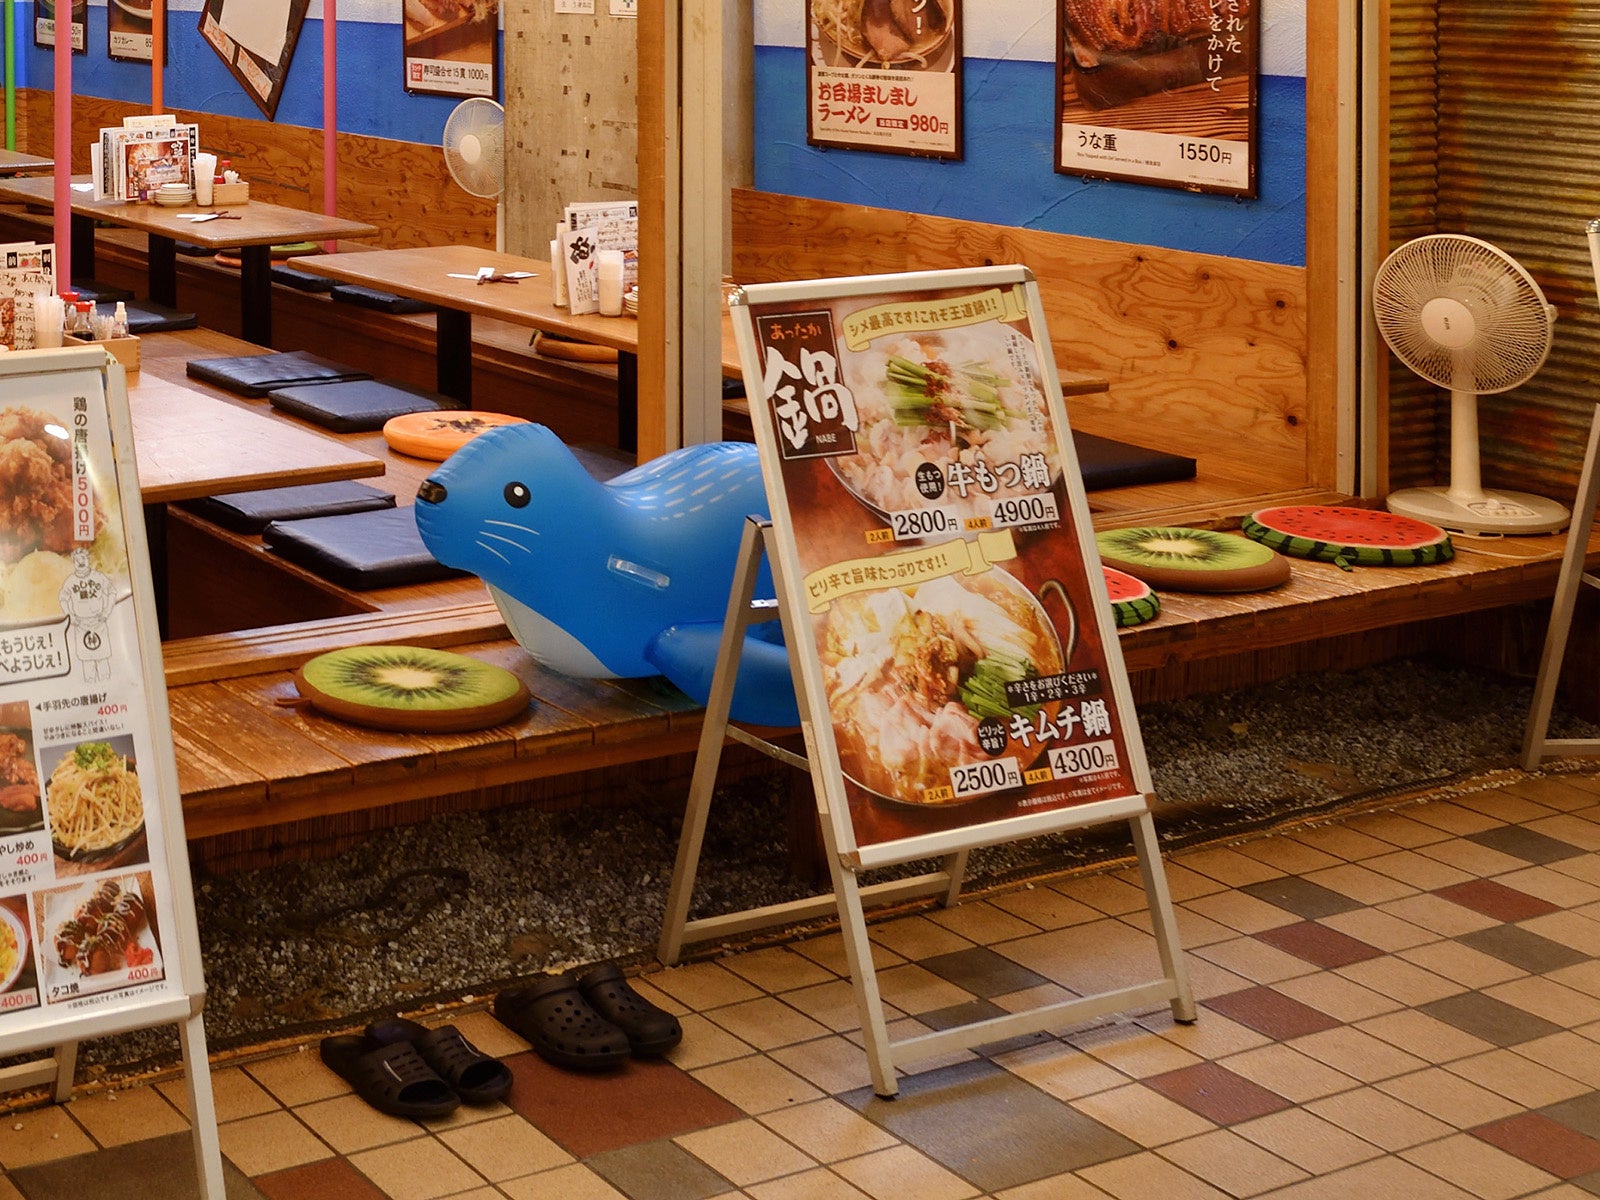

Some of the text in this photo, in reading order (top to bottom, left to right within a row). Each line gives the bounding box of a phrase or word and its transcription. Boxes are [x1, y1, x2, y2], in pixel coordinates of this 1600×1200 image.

[817, 103, 871, 125] ラーメン
[909, 114, 949, 135] 980円
[1077, 129, 1232, 165] うな重 1550円
[770, 321, 822, 341] あったか
[849, 297, 998, 337] シメ最高です!これぞ王道鍋!!
[763, 346, 860, 450] 鍋
[815, 433, 837, 444] NABE
[947, 452, 1051, 498] 牛もつ鍋
[869, 497, 1056, 543] 2人前 2800円 4人前 4900円
[43, 692, 108, 712] 手羽先の唐揚げ
[97, 703, 128, 716] 400円
[1010, 698, 1112, 749] キムチ鍋
[927, 745, 1115, 801] 2人前 2500円 4人前 4300円
[16, 852, 48, 866] 400円
[51, 966, 159, 997] タコ焼 400円
[0, 994, 34, 1009] 400円
